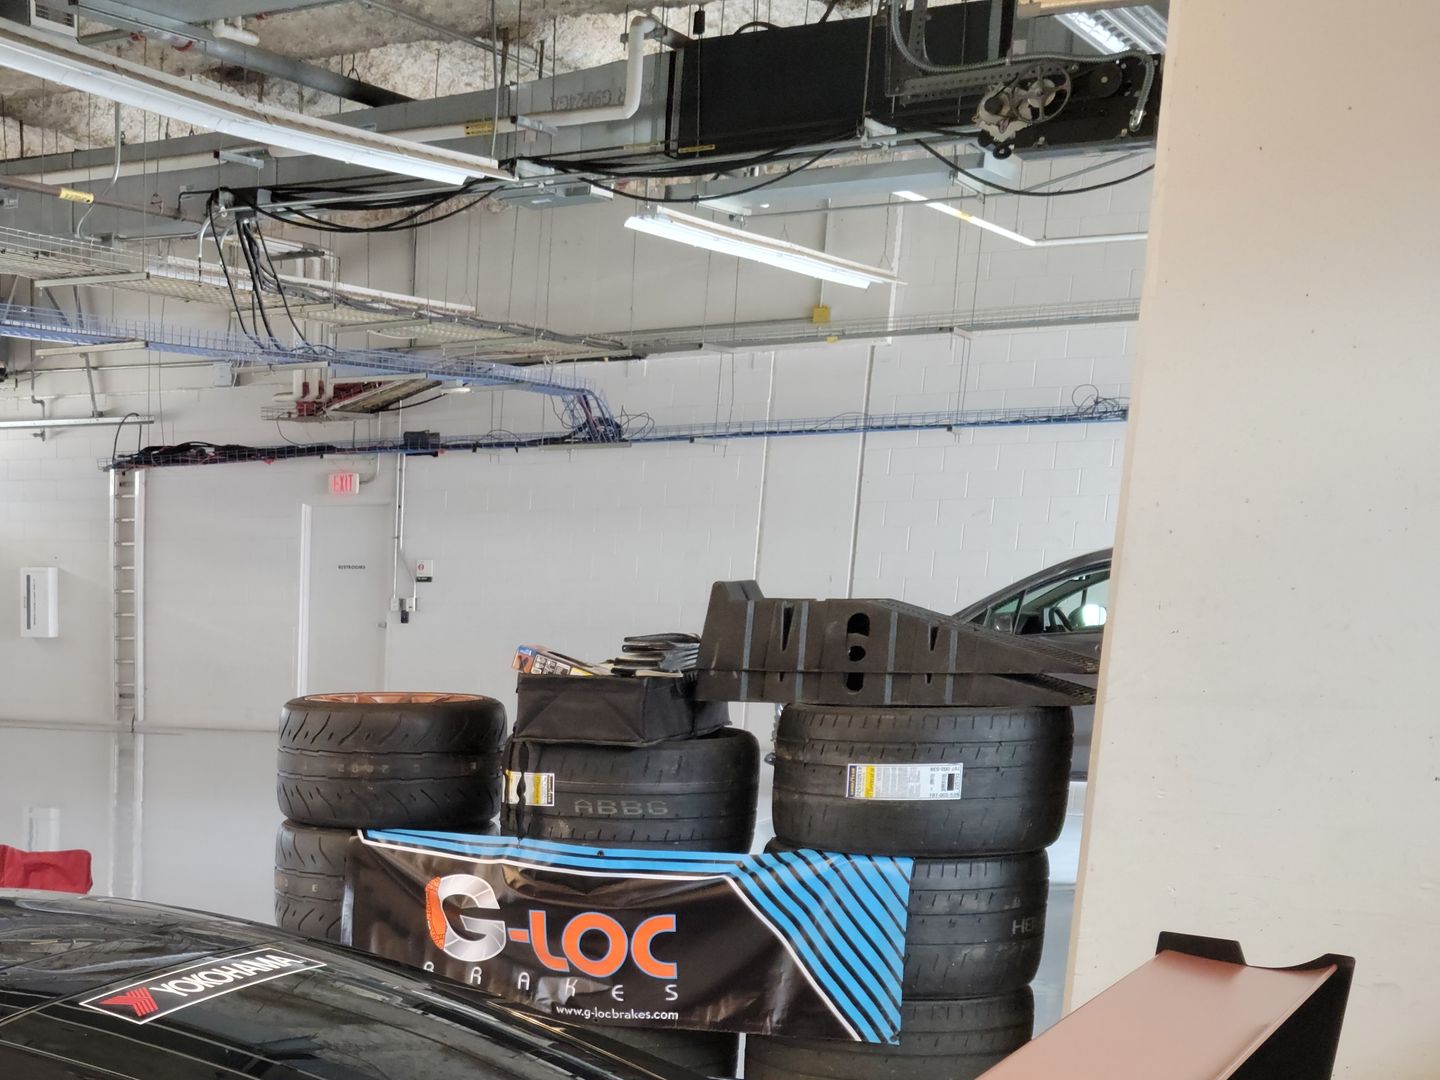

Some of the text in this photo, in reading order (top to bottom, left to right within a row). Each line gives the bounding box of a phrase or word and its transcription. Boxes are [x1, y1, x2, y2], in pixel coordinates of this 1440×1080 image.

[332, 474, 354, 494] EXIT
[425, 873, 678, 980] G-LOC
[149, 954, 299, 997] YOKOHAMA
[555, 1005, 679, 1020] www.g-locbrakes.com
